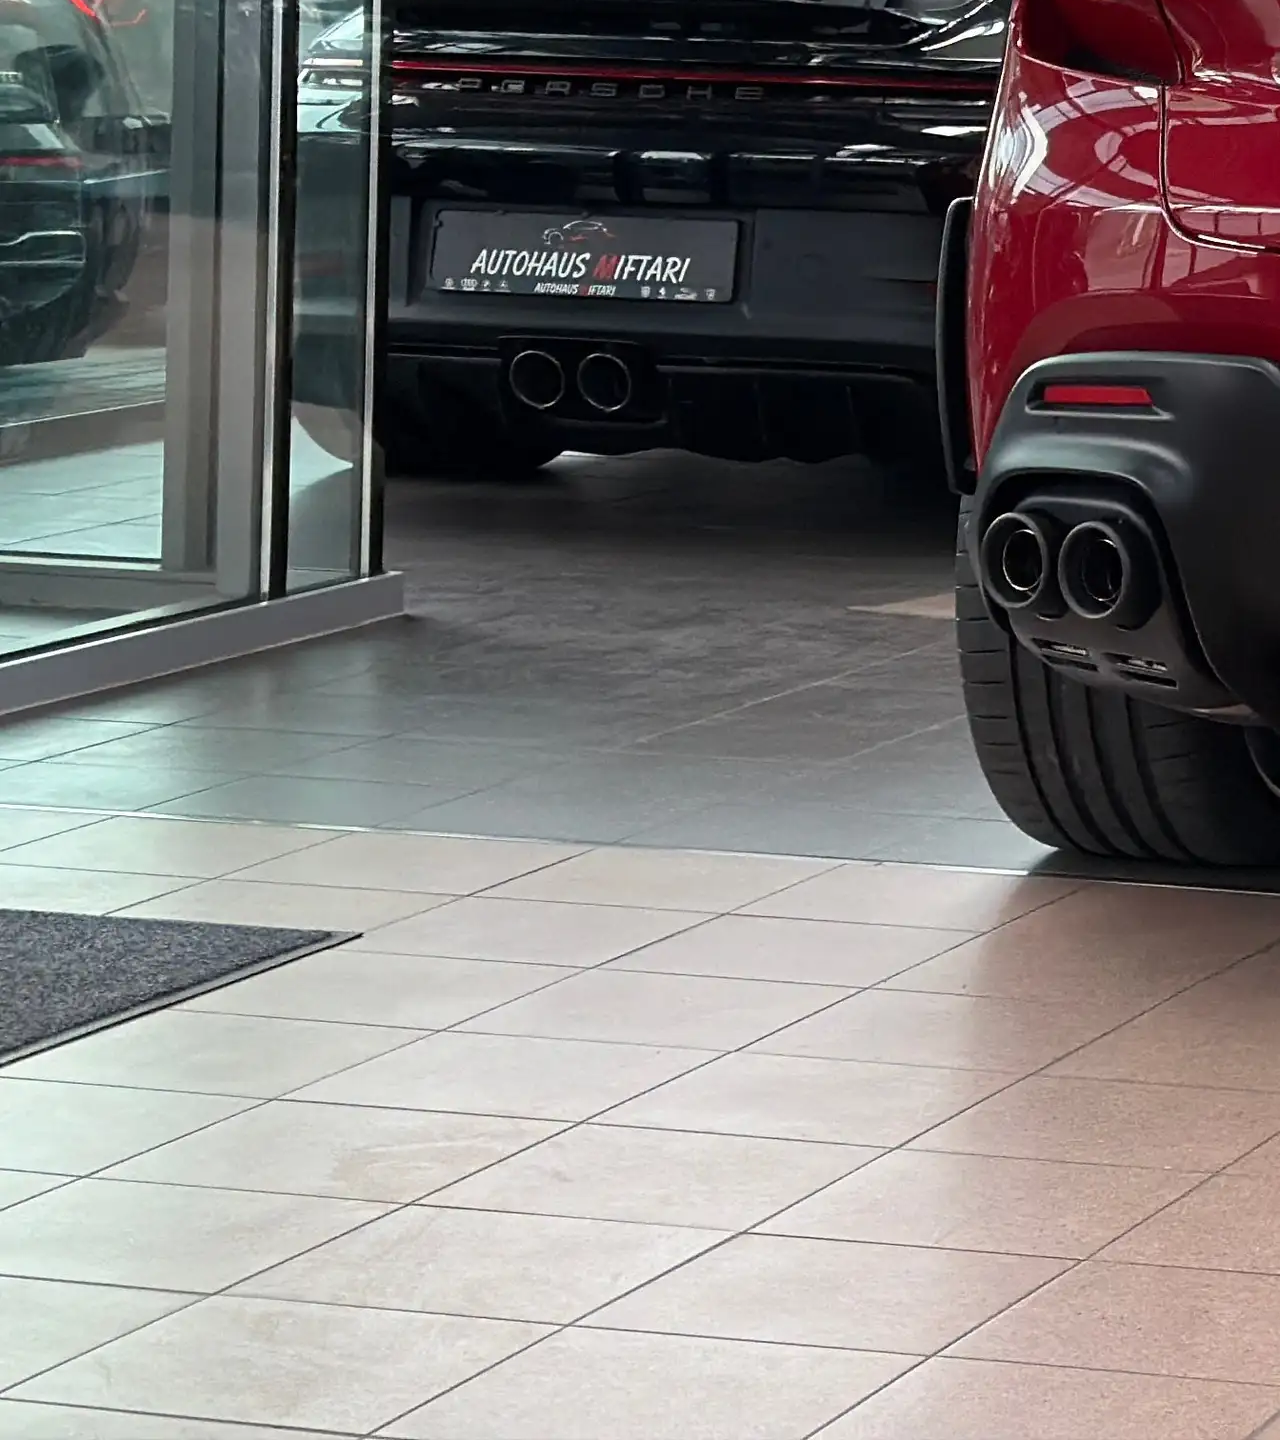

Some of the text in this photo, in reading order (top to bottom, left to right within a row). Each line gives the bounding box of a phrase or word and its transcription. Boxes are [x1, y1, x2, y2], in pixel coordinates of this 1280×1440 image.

[470, 249, 691, 284] AUTOHAUS MIFTARI
[534, 282, 579, 295] AUTOHAUS
